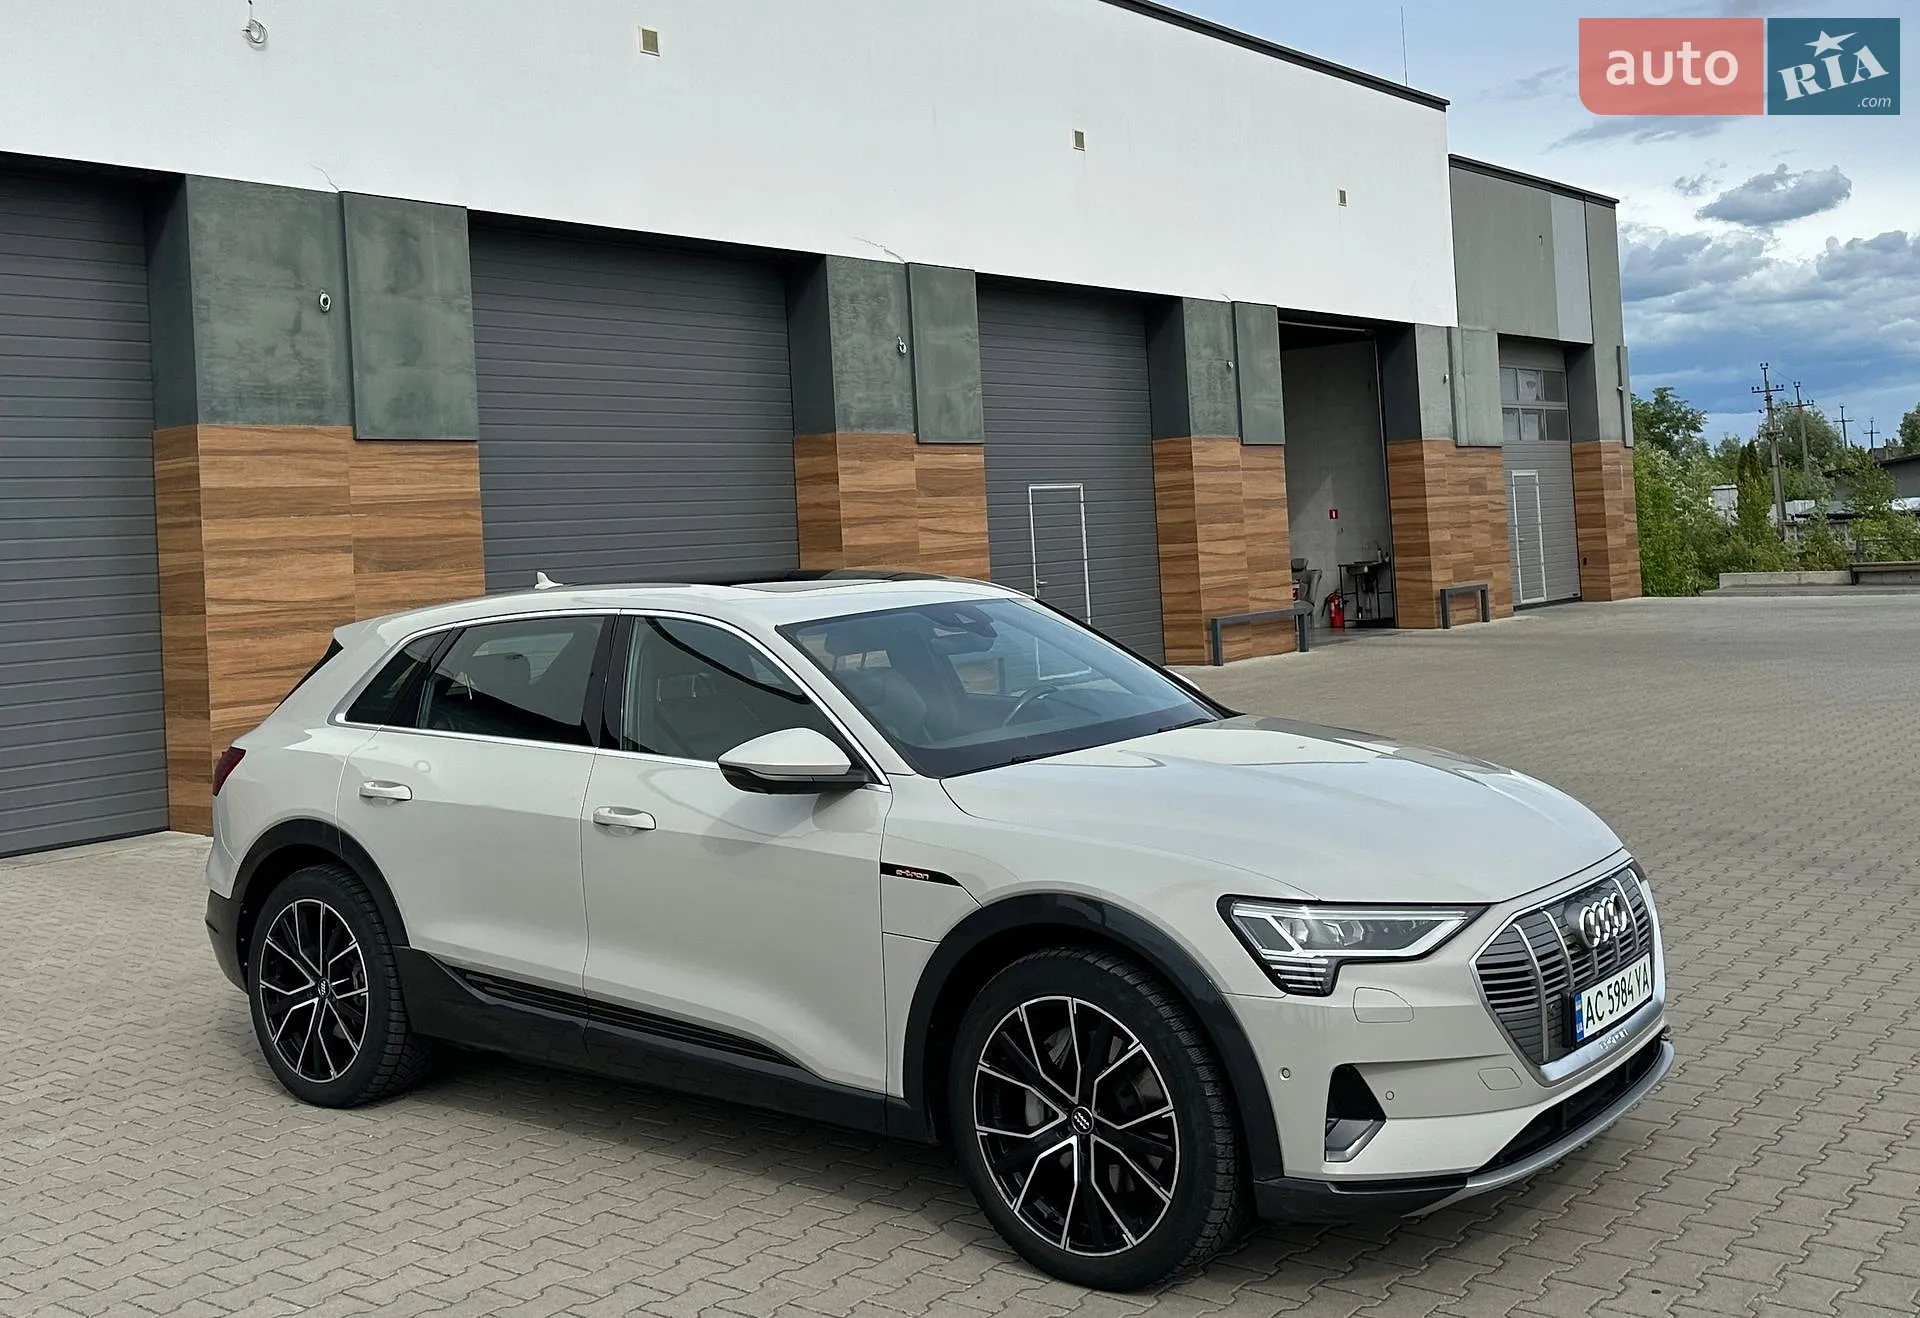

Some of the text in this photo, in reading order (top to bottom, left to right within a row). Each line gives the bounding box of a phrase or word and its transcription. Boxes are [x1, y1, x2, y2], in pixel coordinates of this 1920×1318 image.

[896, 869, 929, 881] e-tron
[1586, 962, 1650, 1029] AC 5984 YA
